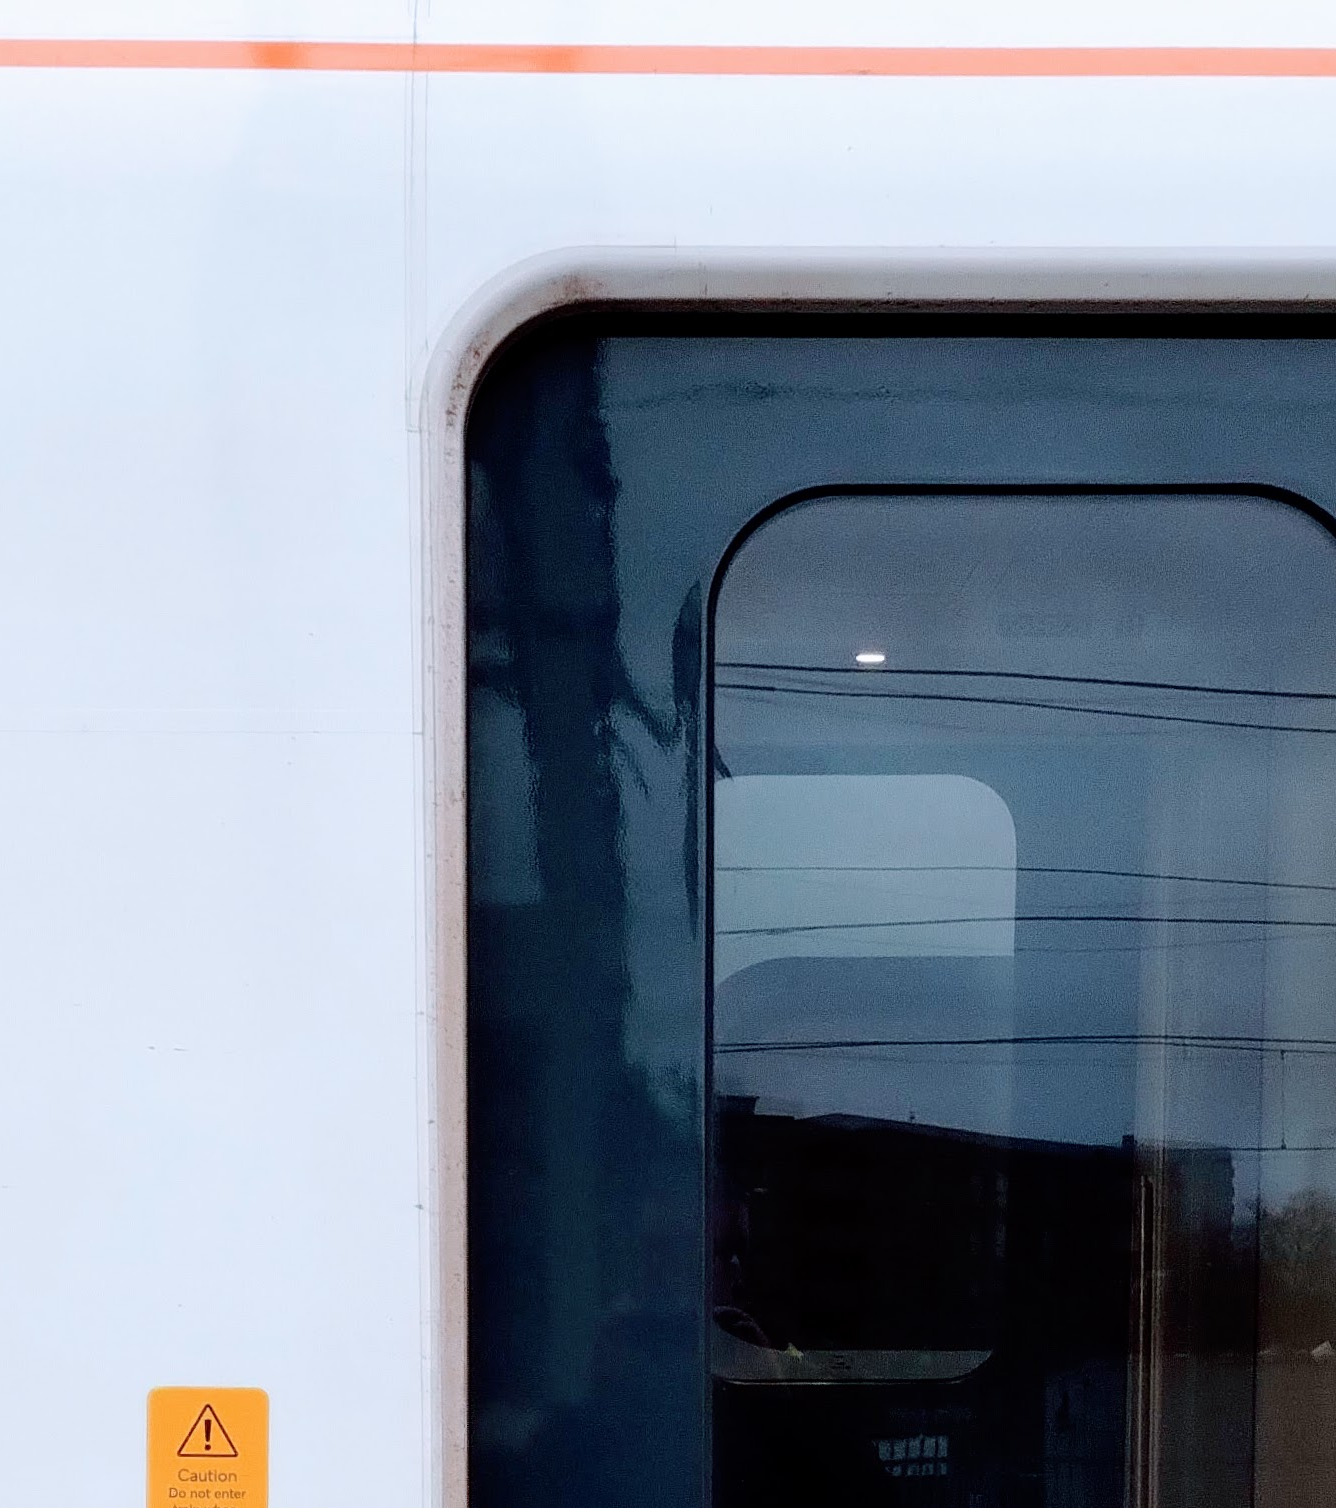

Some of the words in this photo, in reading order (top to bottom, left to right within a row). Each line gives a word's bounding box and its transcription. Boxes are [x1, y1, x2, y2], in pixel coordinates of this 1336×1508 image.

[177, 1468, 238, 1482] Caution
[169, 1487, 187, 1499] Do
[190, 1488, 211, 1499] not
[214, 1488, 246, 1499] enter
